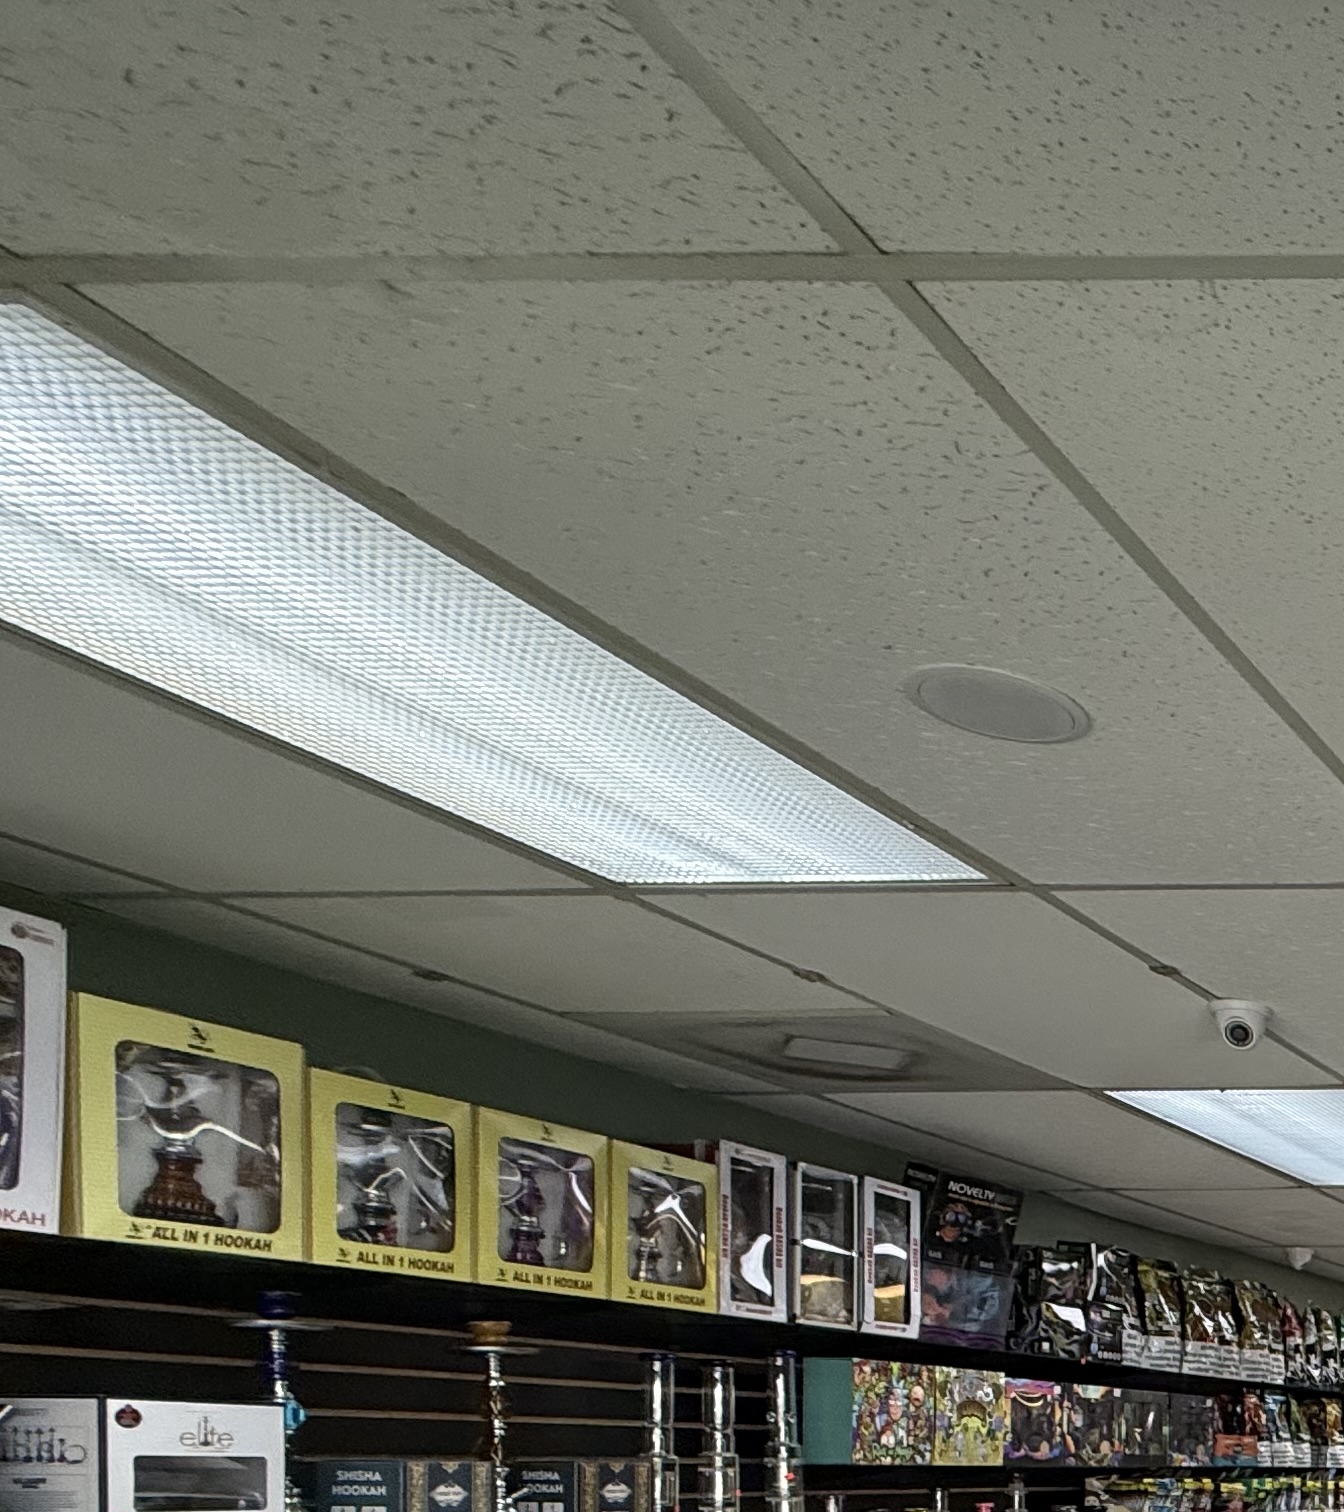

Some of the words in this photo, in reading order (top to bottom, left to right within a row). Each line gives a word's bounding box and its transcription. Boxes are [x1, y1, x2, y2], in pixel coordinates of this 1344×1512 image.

[948, 1181, 996, 1200] NOVELTY
[151, 1226, 176, 1241] ALL
[182, 1229, 198, 1243] IN
[202, 1231, 208, 1244] 1
[214, 1233, 272, 1252] HOOKAH
[356, 1251, 378, 1264] ALL
[381, 1254, 395, 1266] IN
[399, 1256, 405, 1267] 1
[408, 1256, 455, 1274] HOOKAH
[513, 1271, 531, 1284] ALL
[533, 1273, 545, 1284] IN
[554, 1276, 592, 1291] HOOKAH
[640, 1289, 655, 1300] ALL
[657, 1290, 665, 1301] IN
[673, 1293, 705, 1306] HOOKAH
[336, 1470, 383, 1482] SHISHA
[522, 1470, 560, 1481] SHISHA
[331, 1484, 387, 1496] HOOKAH
